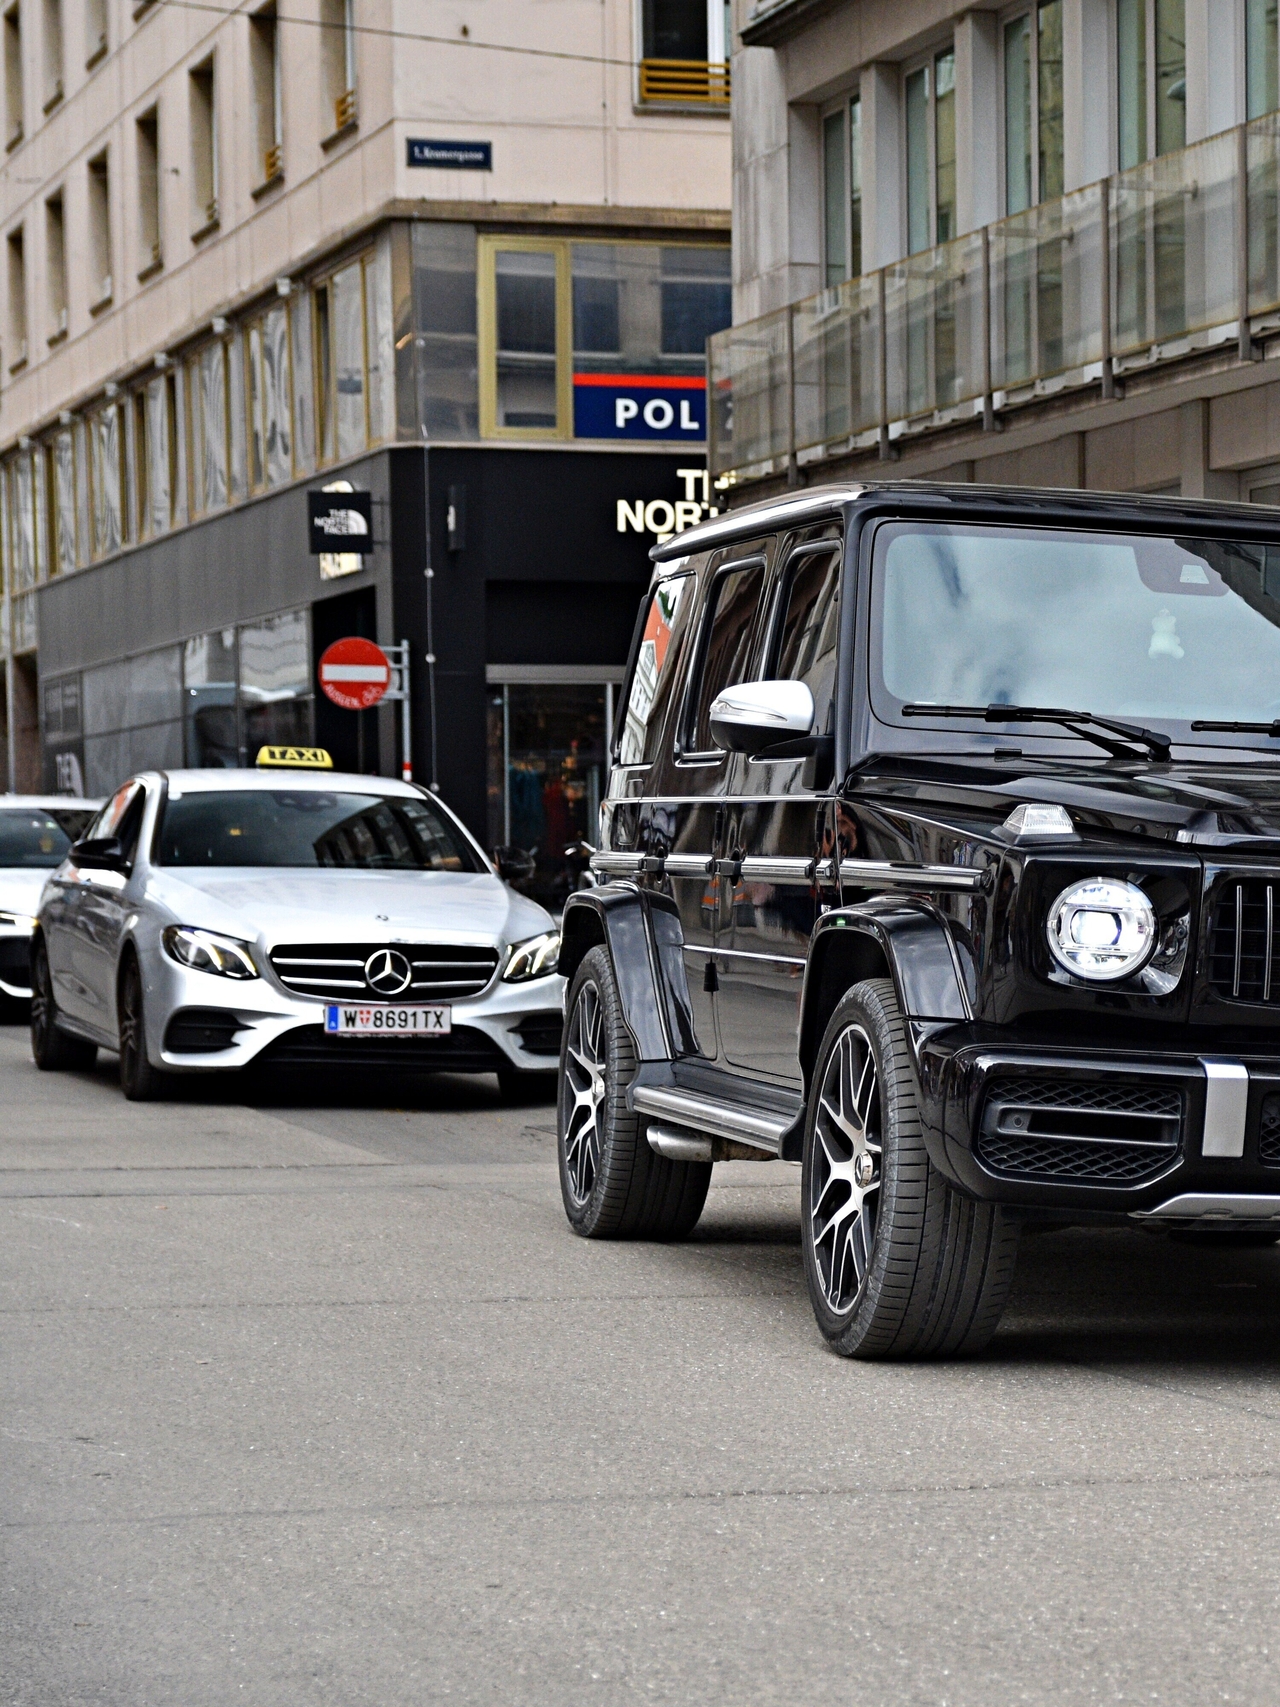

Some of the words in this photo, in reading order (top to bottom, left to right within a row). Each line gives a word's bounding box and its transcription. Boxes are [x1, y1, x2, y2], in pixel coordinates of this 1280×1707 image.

[615, 398, 700, 430] POL
[616, 499, 719, 533] NOR
[268, 748, 324, 762] TAXI
[344, 1010, 357, 1028] W
